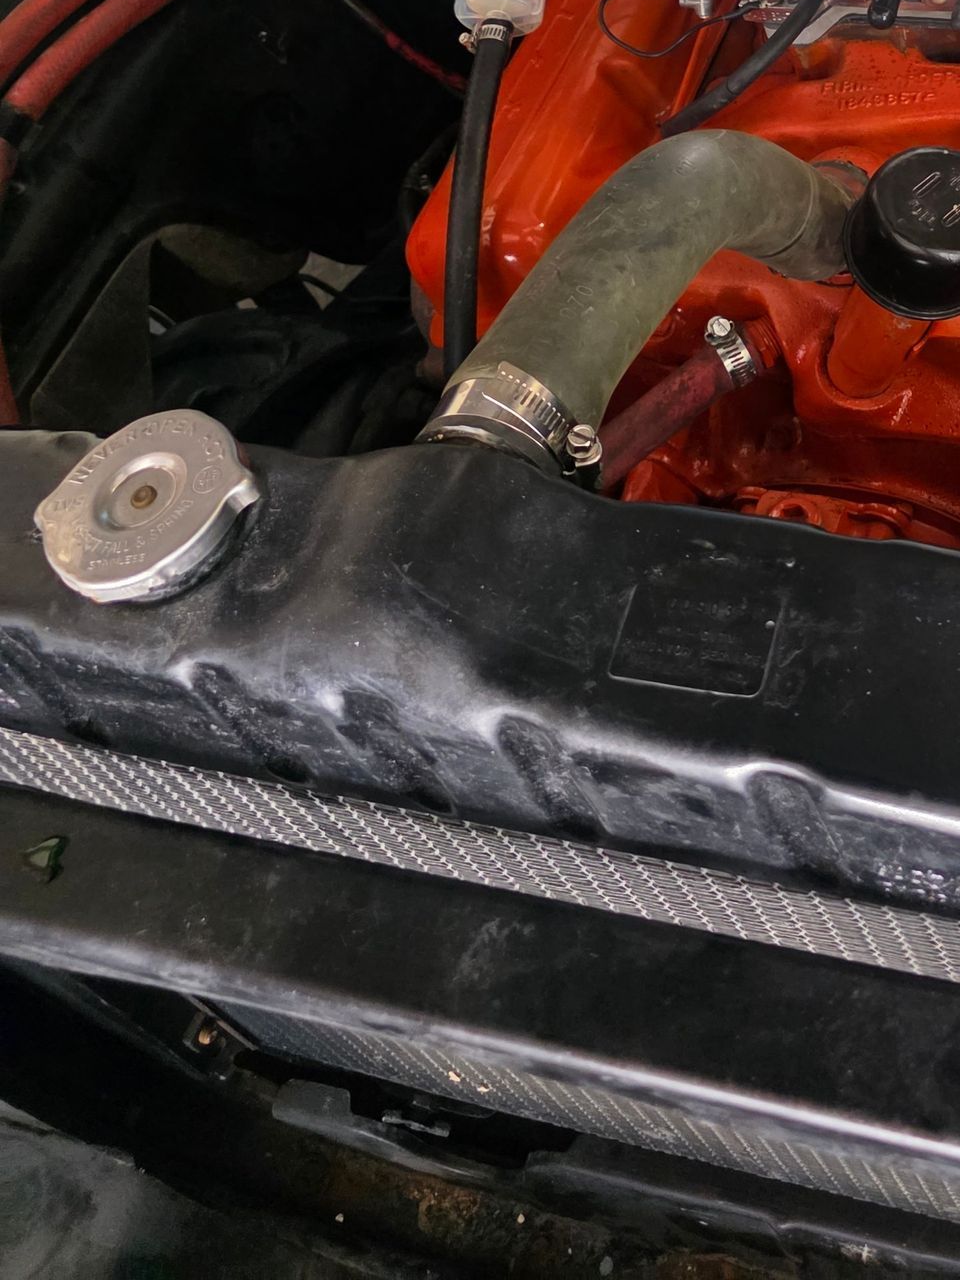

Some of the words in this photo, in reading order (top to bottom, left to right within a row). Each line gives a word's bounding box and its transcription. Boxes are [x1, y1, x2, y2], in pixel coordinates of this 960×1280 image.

[68, 429, 139, 486] NEVER
[142, 418, 194, 437] OPEN
[101, 540, 129, 557] FALL
[149, 499, 194, 543] SPRING
